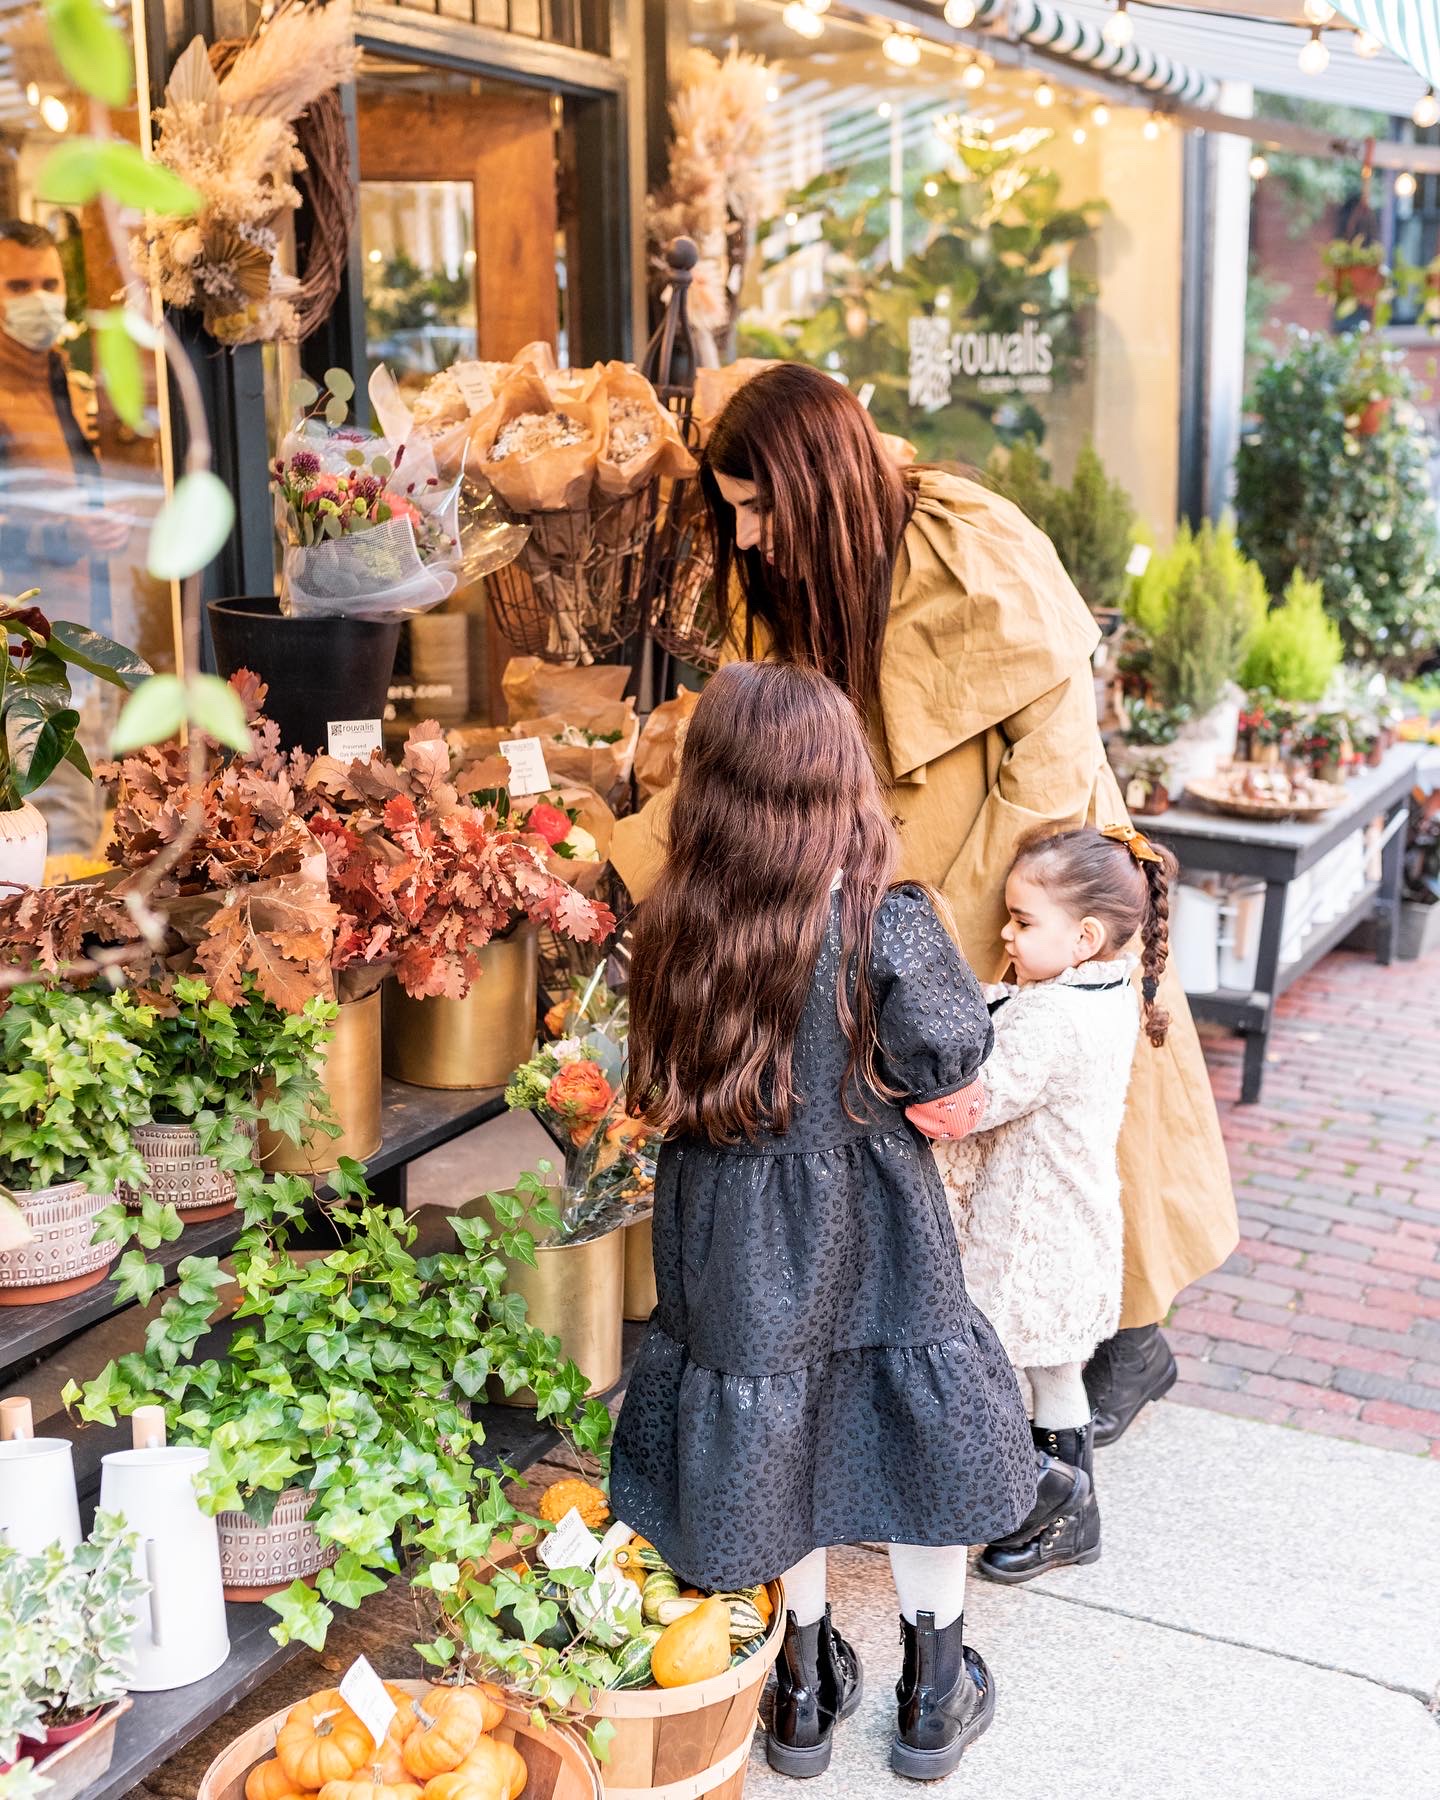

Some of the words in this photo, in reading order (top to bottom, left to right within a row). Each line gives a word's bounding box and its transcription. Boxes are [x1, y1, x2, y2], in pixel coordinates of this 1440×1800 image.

[951, 320, 1053, 375] rouvalis
[342, 722, 374, 732] rouvalis
[549, 1517, 574, 1543] rouvalis
